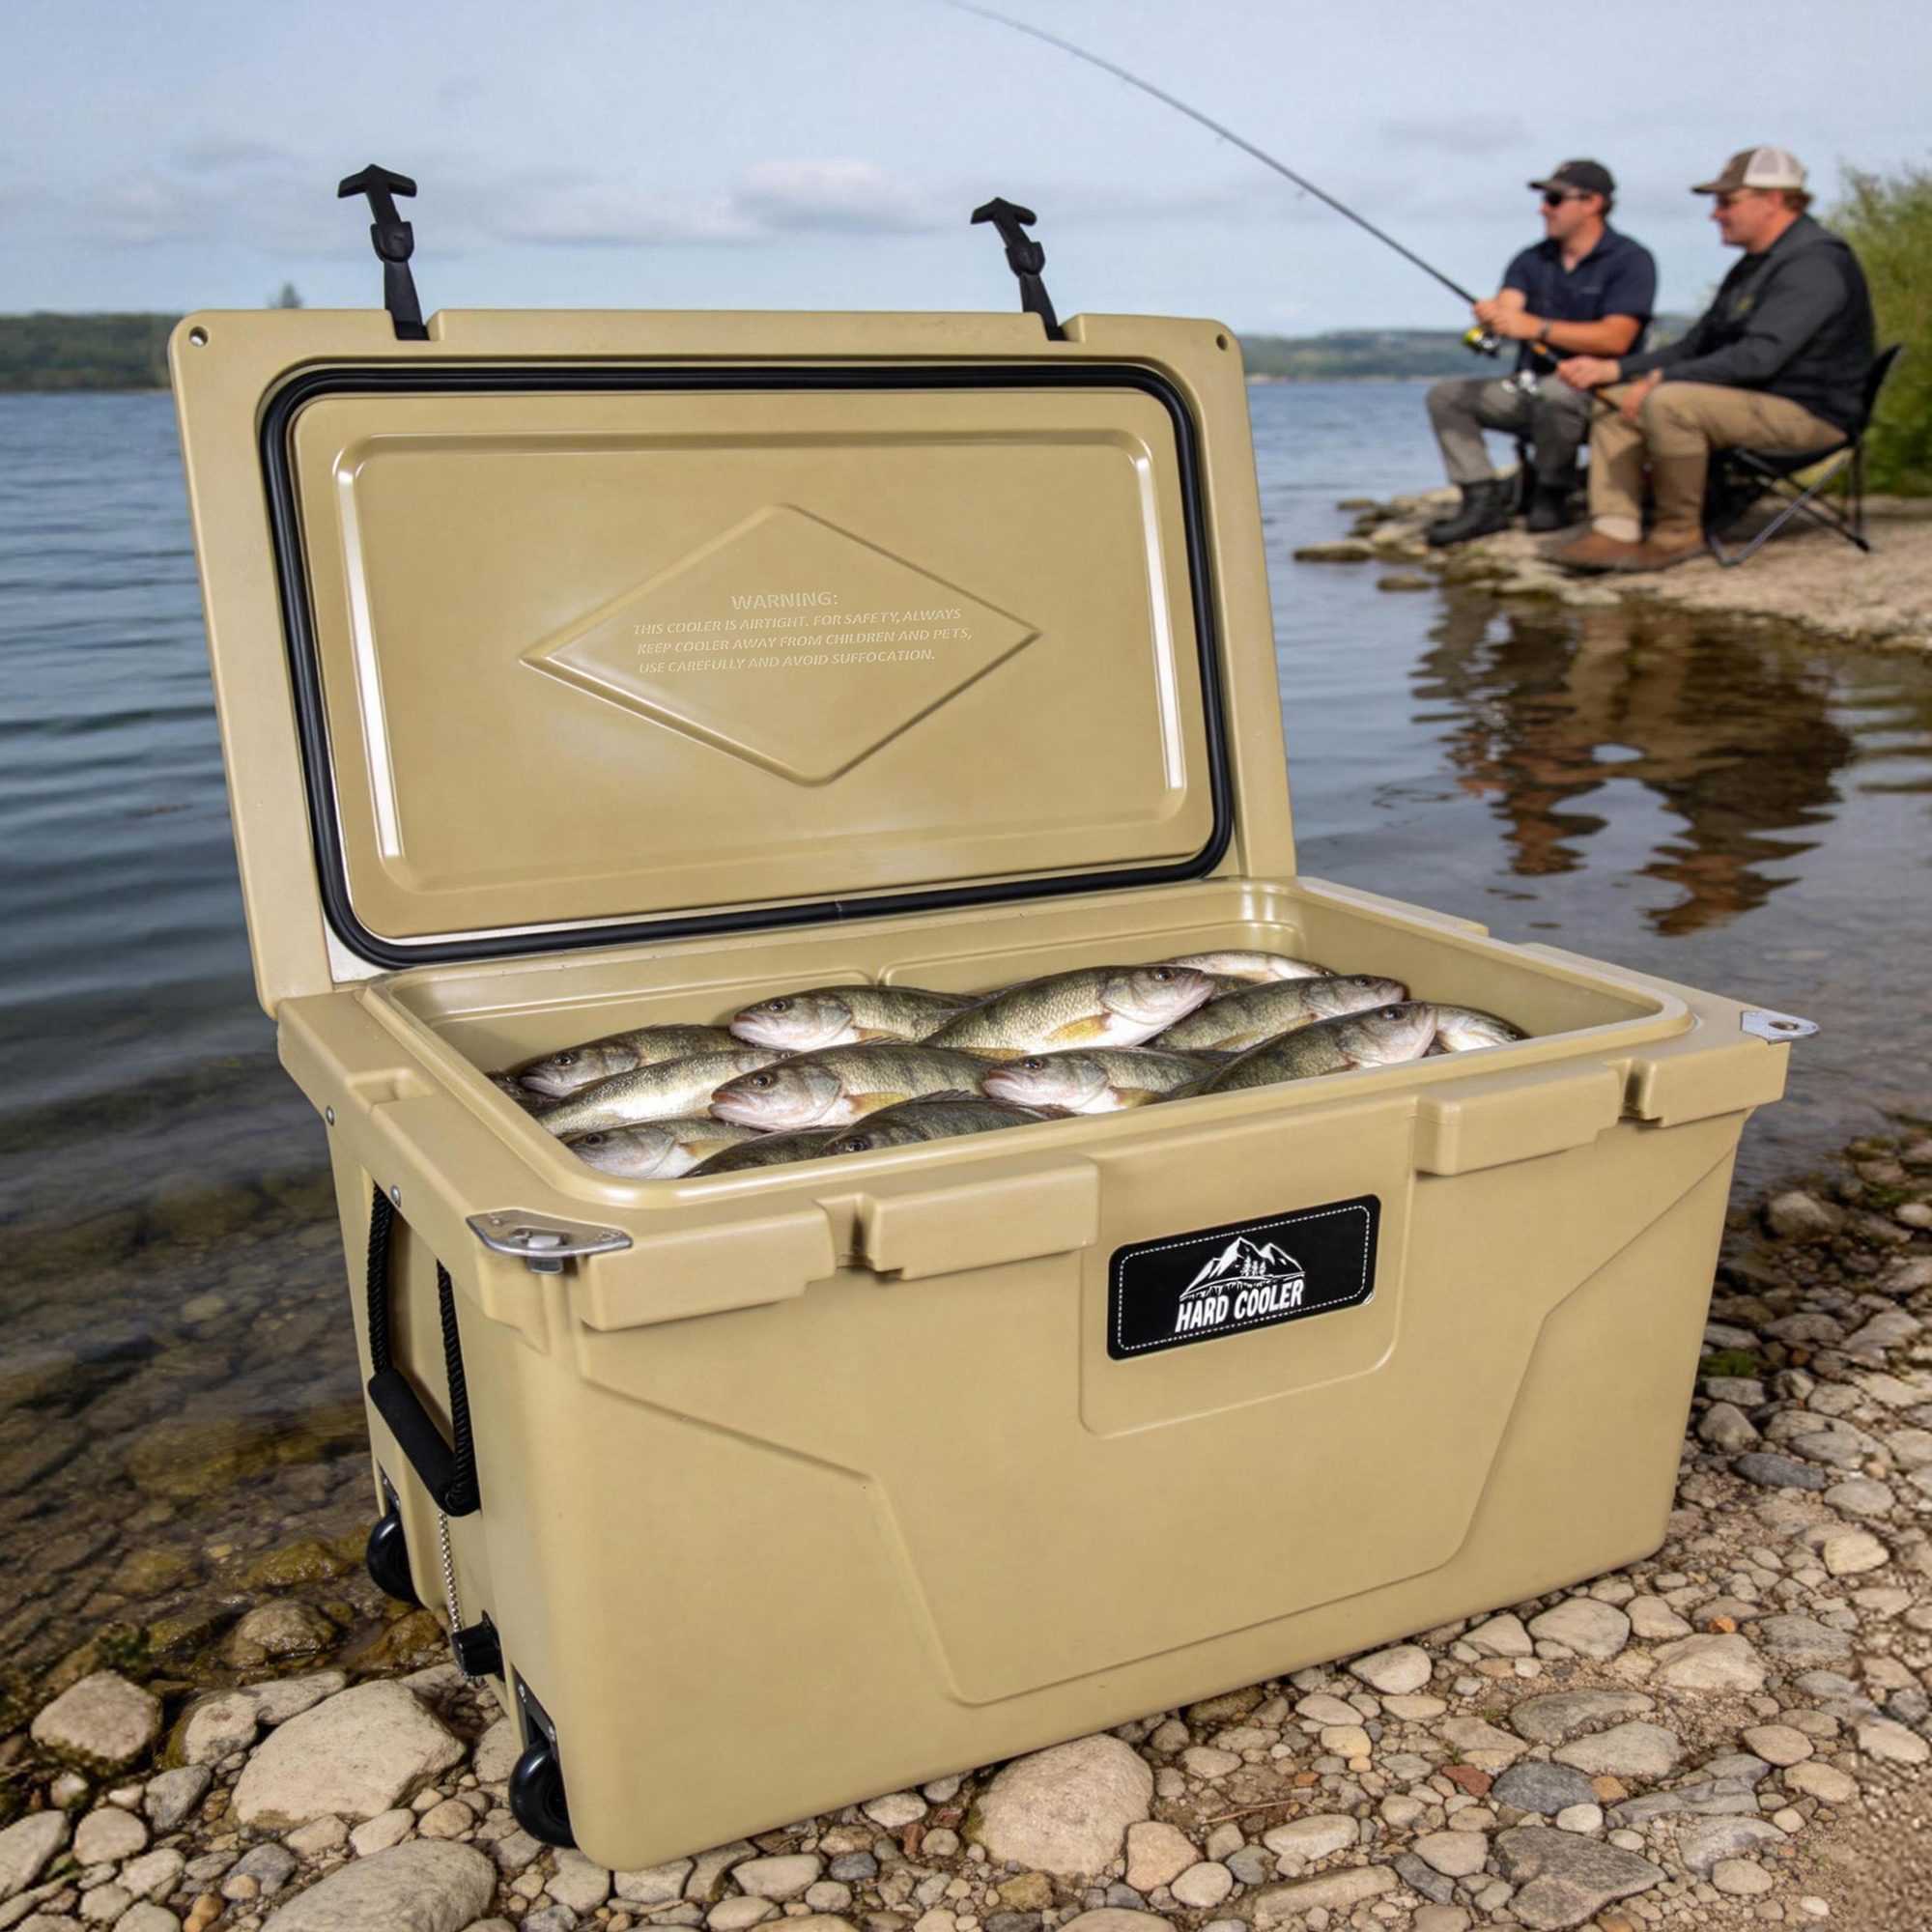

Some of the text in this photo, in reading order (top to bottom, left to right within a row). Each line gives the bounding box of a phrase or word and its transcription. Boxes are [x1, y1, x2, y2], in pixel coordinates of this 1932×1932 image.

[731, 591, 838, 611] WARNING:
[634, 609, 961, 636] THIS COOLER IS AIRTIGHT. FOR SAFETY, ALWAYS
[638, 627, 972, 655] KEEP COOLER AWAY FROM CHILDREN AND PETS,
[639, 649, 935, 674] USE CAREFULLY AND AVOID SUFFOCATION.
[1175, 1279, 1304, 1333] HARD COOLER
